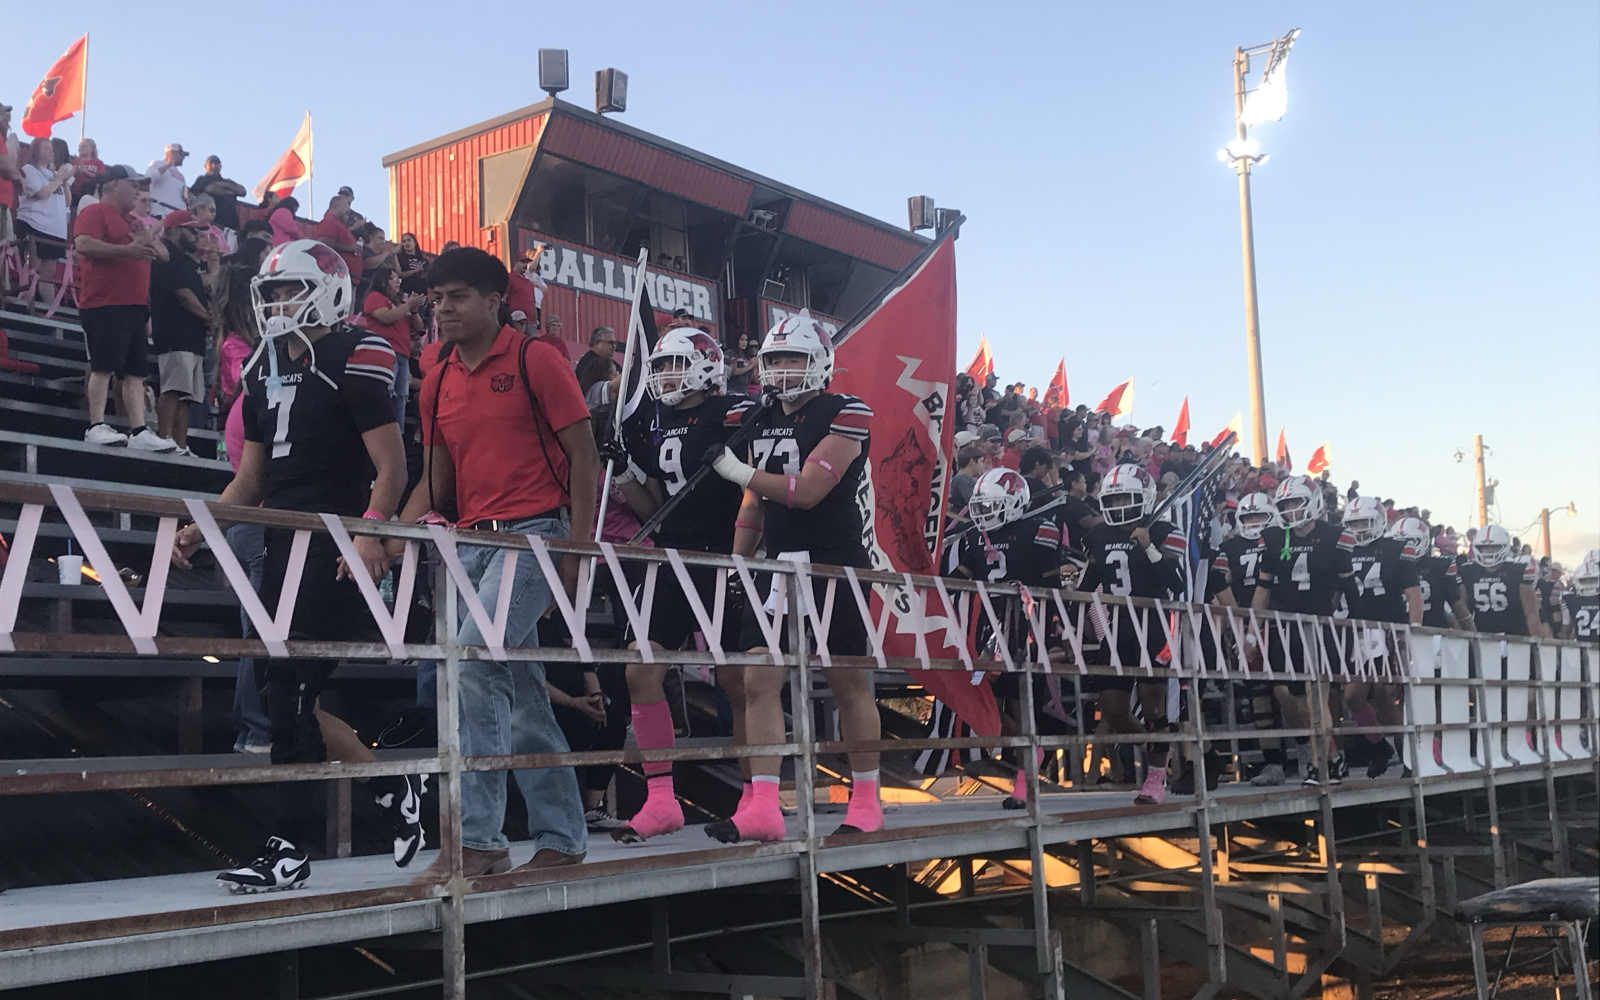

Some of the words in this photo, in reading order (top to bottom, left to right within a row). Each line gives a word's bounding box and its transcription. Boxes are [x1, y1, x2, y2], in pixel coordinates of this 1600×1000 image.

[266, 385, 297, 459] 7
[762, 428, 794, 437] BEARCATS
[659, 436, 688, 497] 9
[1105, 551, 1132, 597] 3
[1291, 552, 1311, 591] 4
[1474, 582, 1508, 612] 56
